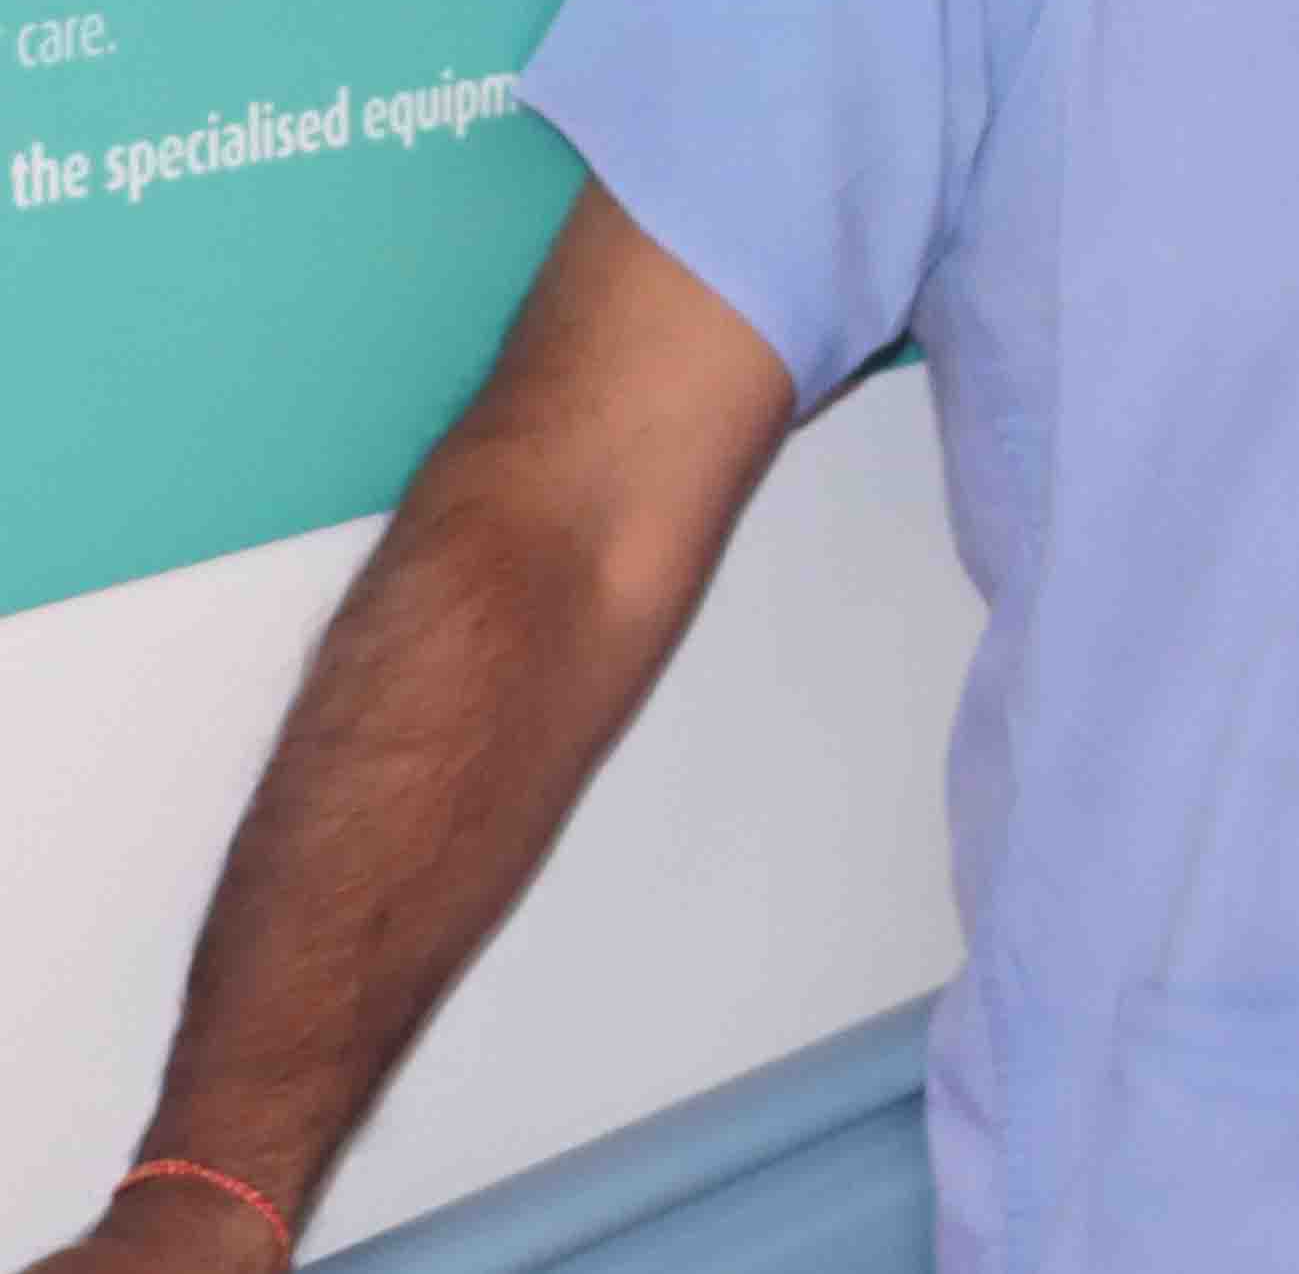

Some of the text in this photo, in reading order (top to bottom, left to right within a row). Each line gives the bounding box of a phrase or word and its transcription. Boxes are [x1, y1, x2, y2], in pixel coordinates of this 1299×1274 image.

[16, 13, 117, 69] care.
[10, 141, 91, 209] the
[104, 86, 351, 203] specialised
